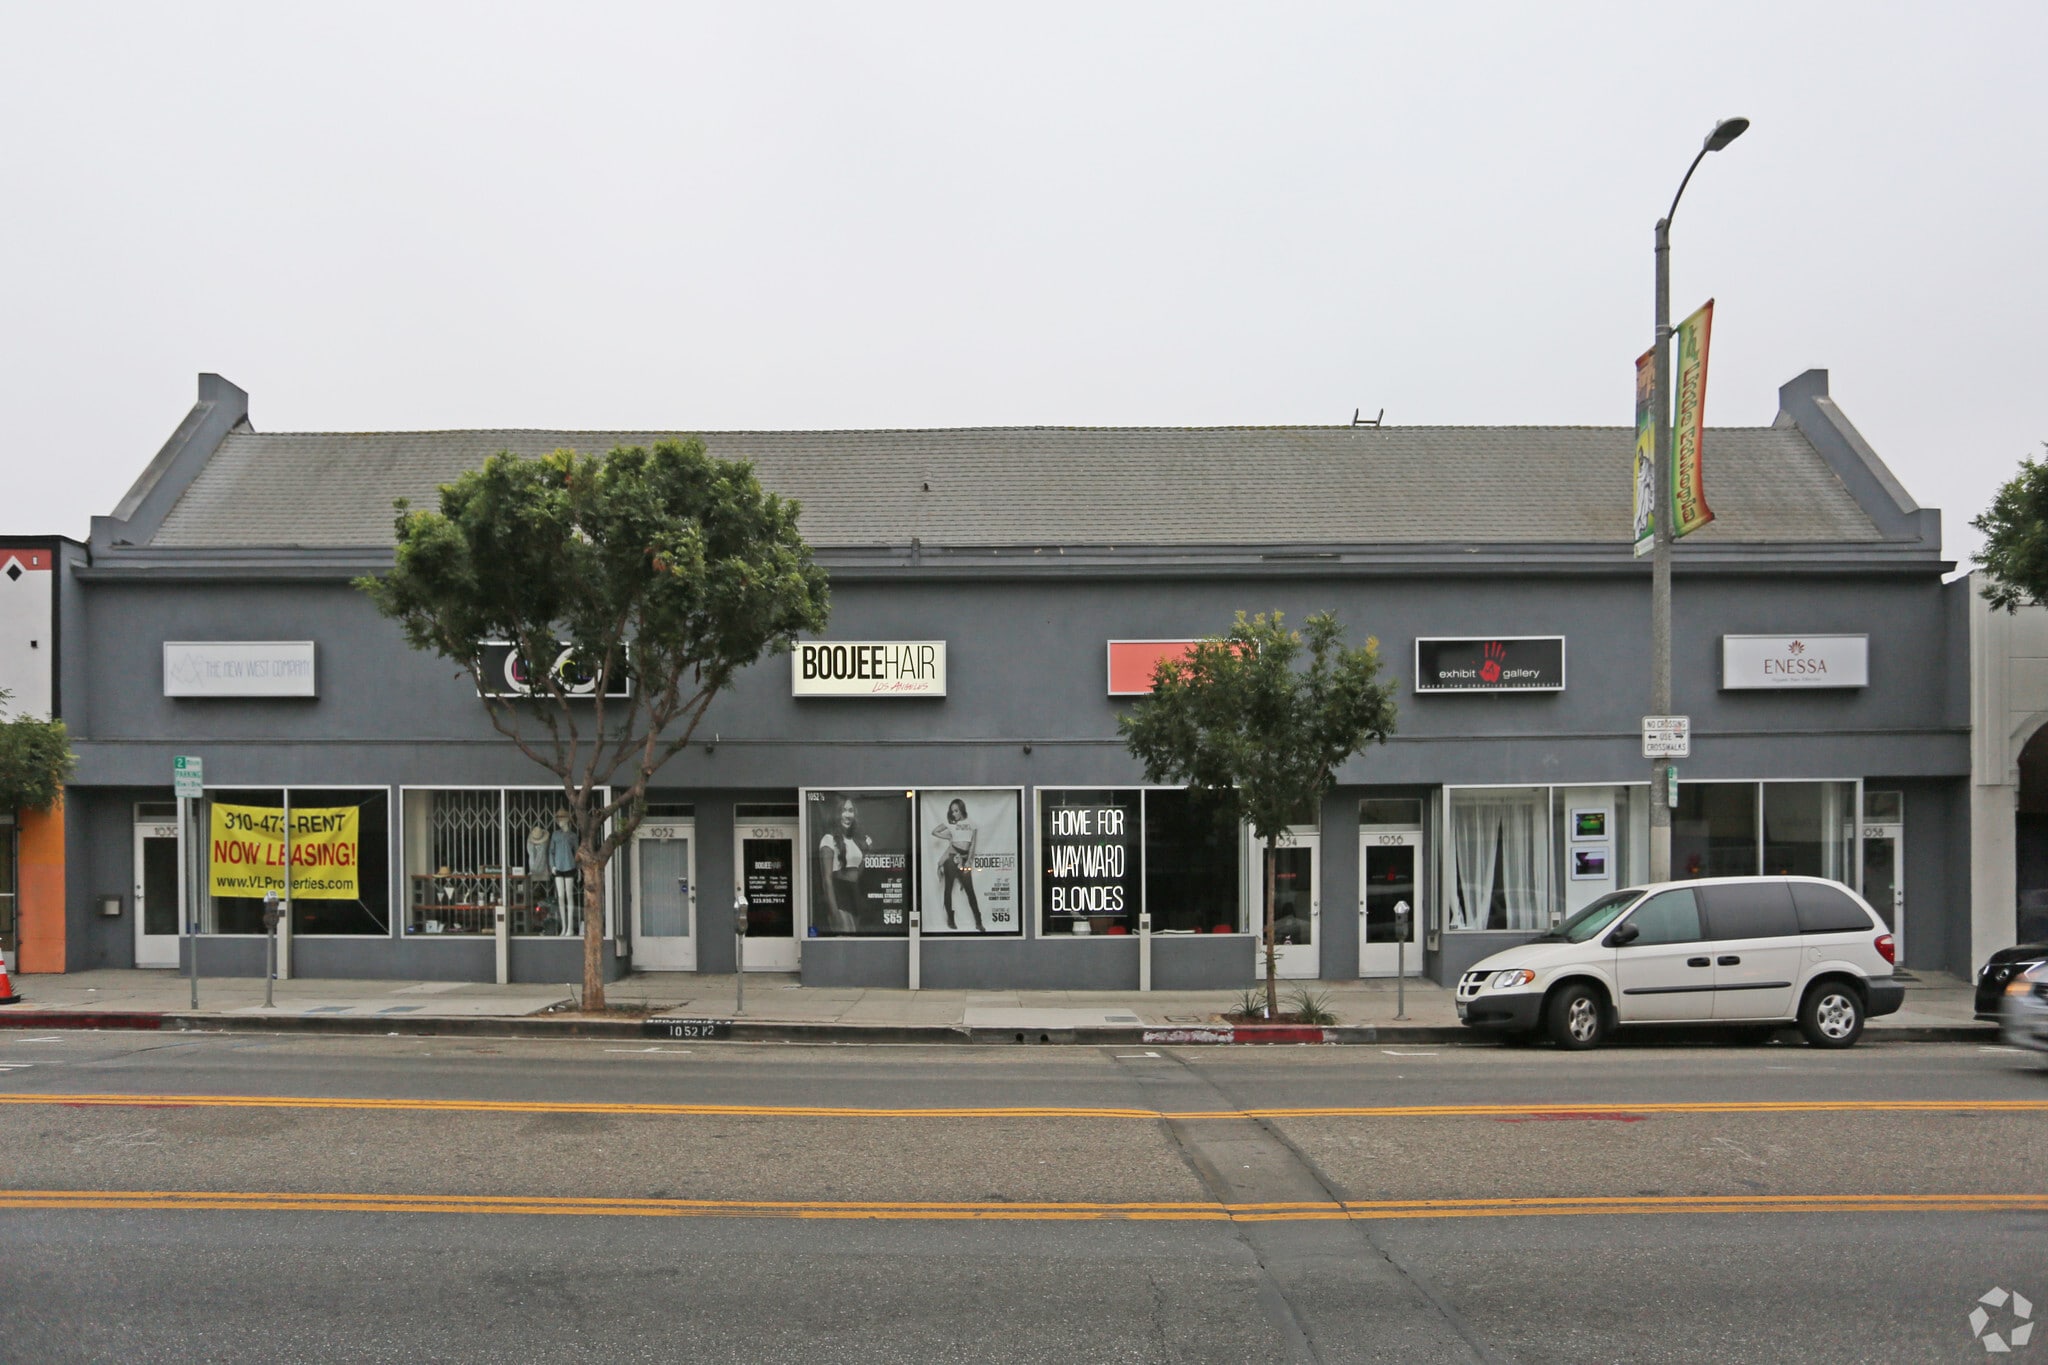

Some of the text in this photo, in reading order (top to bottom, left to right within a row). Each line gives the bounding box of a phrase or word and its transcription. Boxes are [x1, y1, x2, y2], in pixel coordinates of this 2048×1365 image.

[1676, 362, 1701, 524] Little Ethiopia
[803, 646, 935, 679] BOOJEEHAIR
[1765, 659, 1827, 674] ENESSA
[206, 660, 222, 678] THE
[223, 660, 244, 678] NEW
[247, 660, 270, 678] WEST
[1439, 669, 1540, 680] exhibit gallery
[1647, 720, 1686, 729] NO CROSSING
[1660, 733, 1673, 741] USE
[1647, 743, 1686, 751] CROSSWALKS
[177, 758, 184, 767] 2
[176, 770, 201, 778] PARKING
[808, 792, 820, 802] 1052
[225, 812, 346, 834] 310-473-RENT
[1052, 809, 1124, 836] HOME FOR
[651, 828, 675, 838] 1052
[1864, 828, 1884, 837] 058
[1379, 835, 1404, 845] 1056
[214, 840, 356, 866] NOW LEASING!
[865, 857, 905, 869] BOOJEEHAIR
[974, 857, 1015, 868] BOOJEEHAIR
[1051, 844, 1125, 878] WAYWARD
[217, 876, 354, 890] www.VLProerties.com
[1052, 886, 1124, 911] BLONDES
[884, 913, 902, 924] $65
[992, 912, 1010, 923] $65
[669, 1025, 699, 1037] 1052
